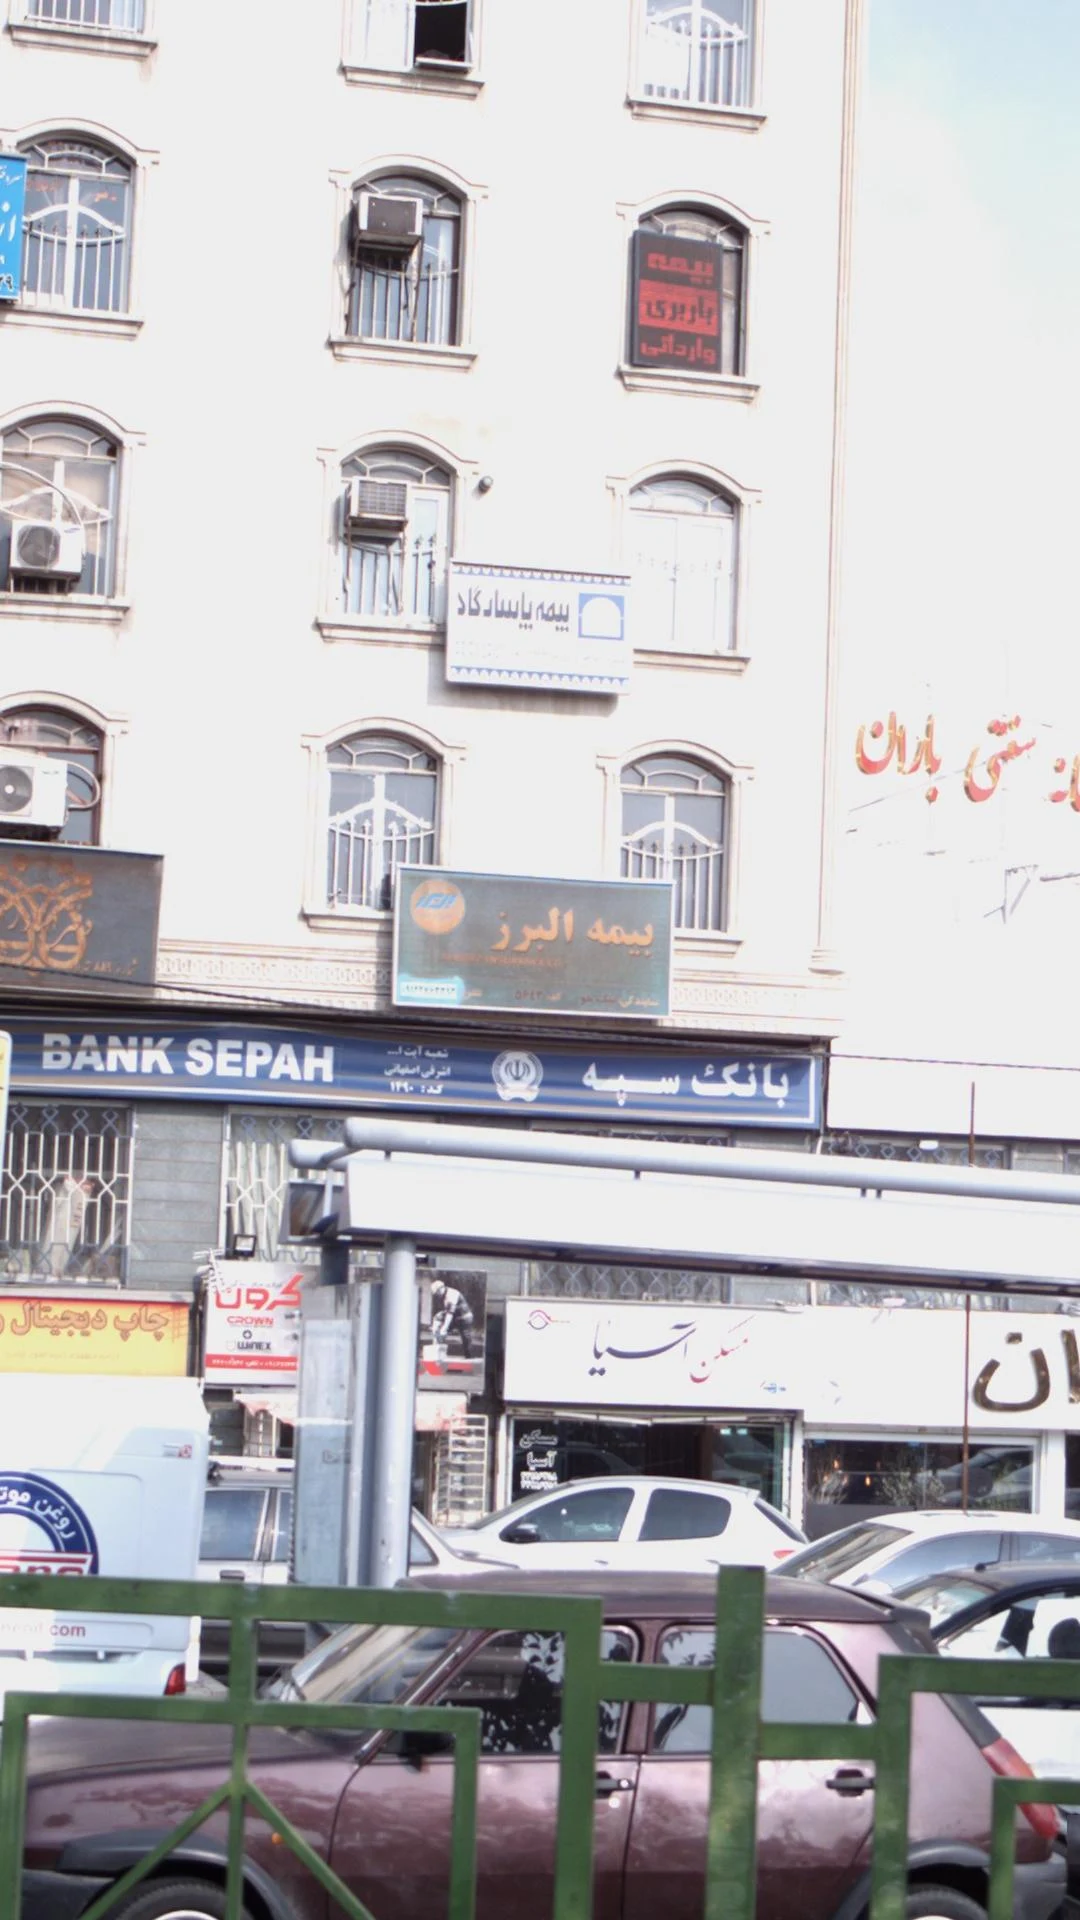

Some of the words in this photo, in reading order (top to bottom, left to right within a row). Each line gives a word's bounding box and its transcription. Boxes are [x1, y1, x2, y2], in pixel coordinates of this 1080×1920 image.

[646, 252, 714, 284] بیمه
[645, 295, 714, 326] باربری
[457, 585, 534, 631] پاسارگاد
[537, 601, 570, 633] بیمه
[489, 905, 575, 953] البرز
[586, 917, 656, 957] بیمه
[42, 1032, 174, 1075] BANK
[184, 1038, 335, 1083] SEPAH
[383, 1063, 420, 1077] اصفهانی
[420, 1065, 452, 1080] اشرفی
[424, 1048, 449, 1060] شعبه
[582, 1061, 682, 1107] سپه
[690, 1061, 790, 1109] بانک
[215, 1273, 304, 1311] کرون
[10, 1300, 108, 1337] دیجیتال
[113, 1303, 169, 1342] چاپ
[226, 1315, 274, 1326] CROWN
[526, 1450, 558, 1472] آسیا
[34, 1499, 76, 1539] روغن
